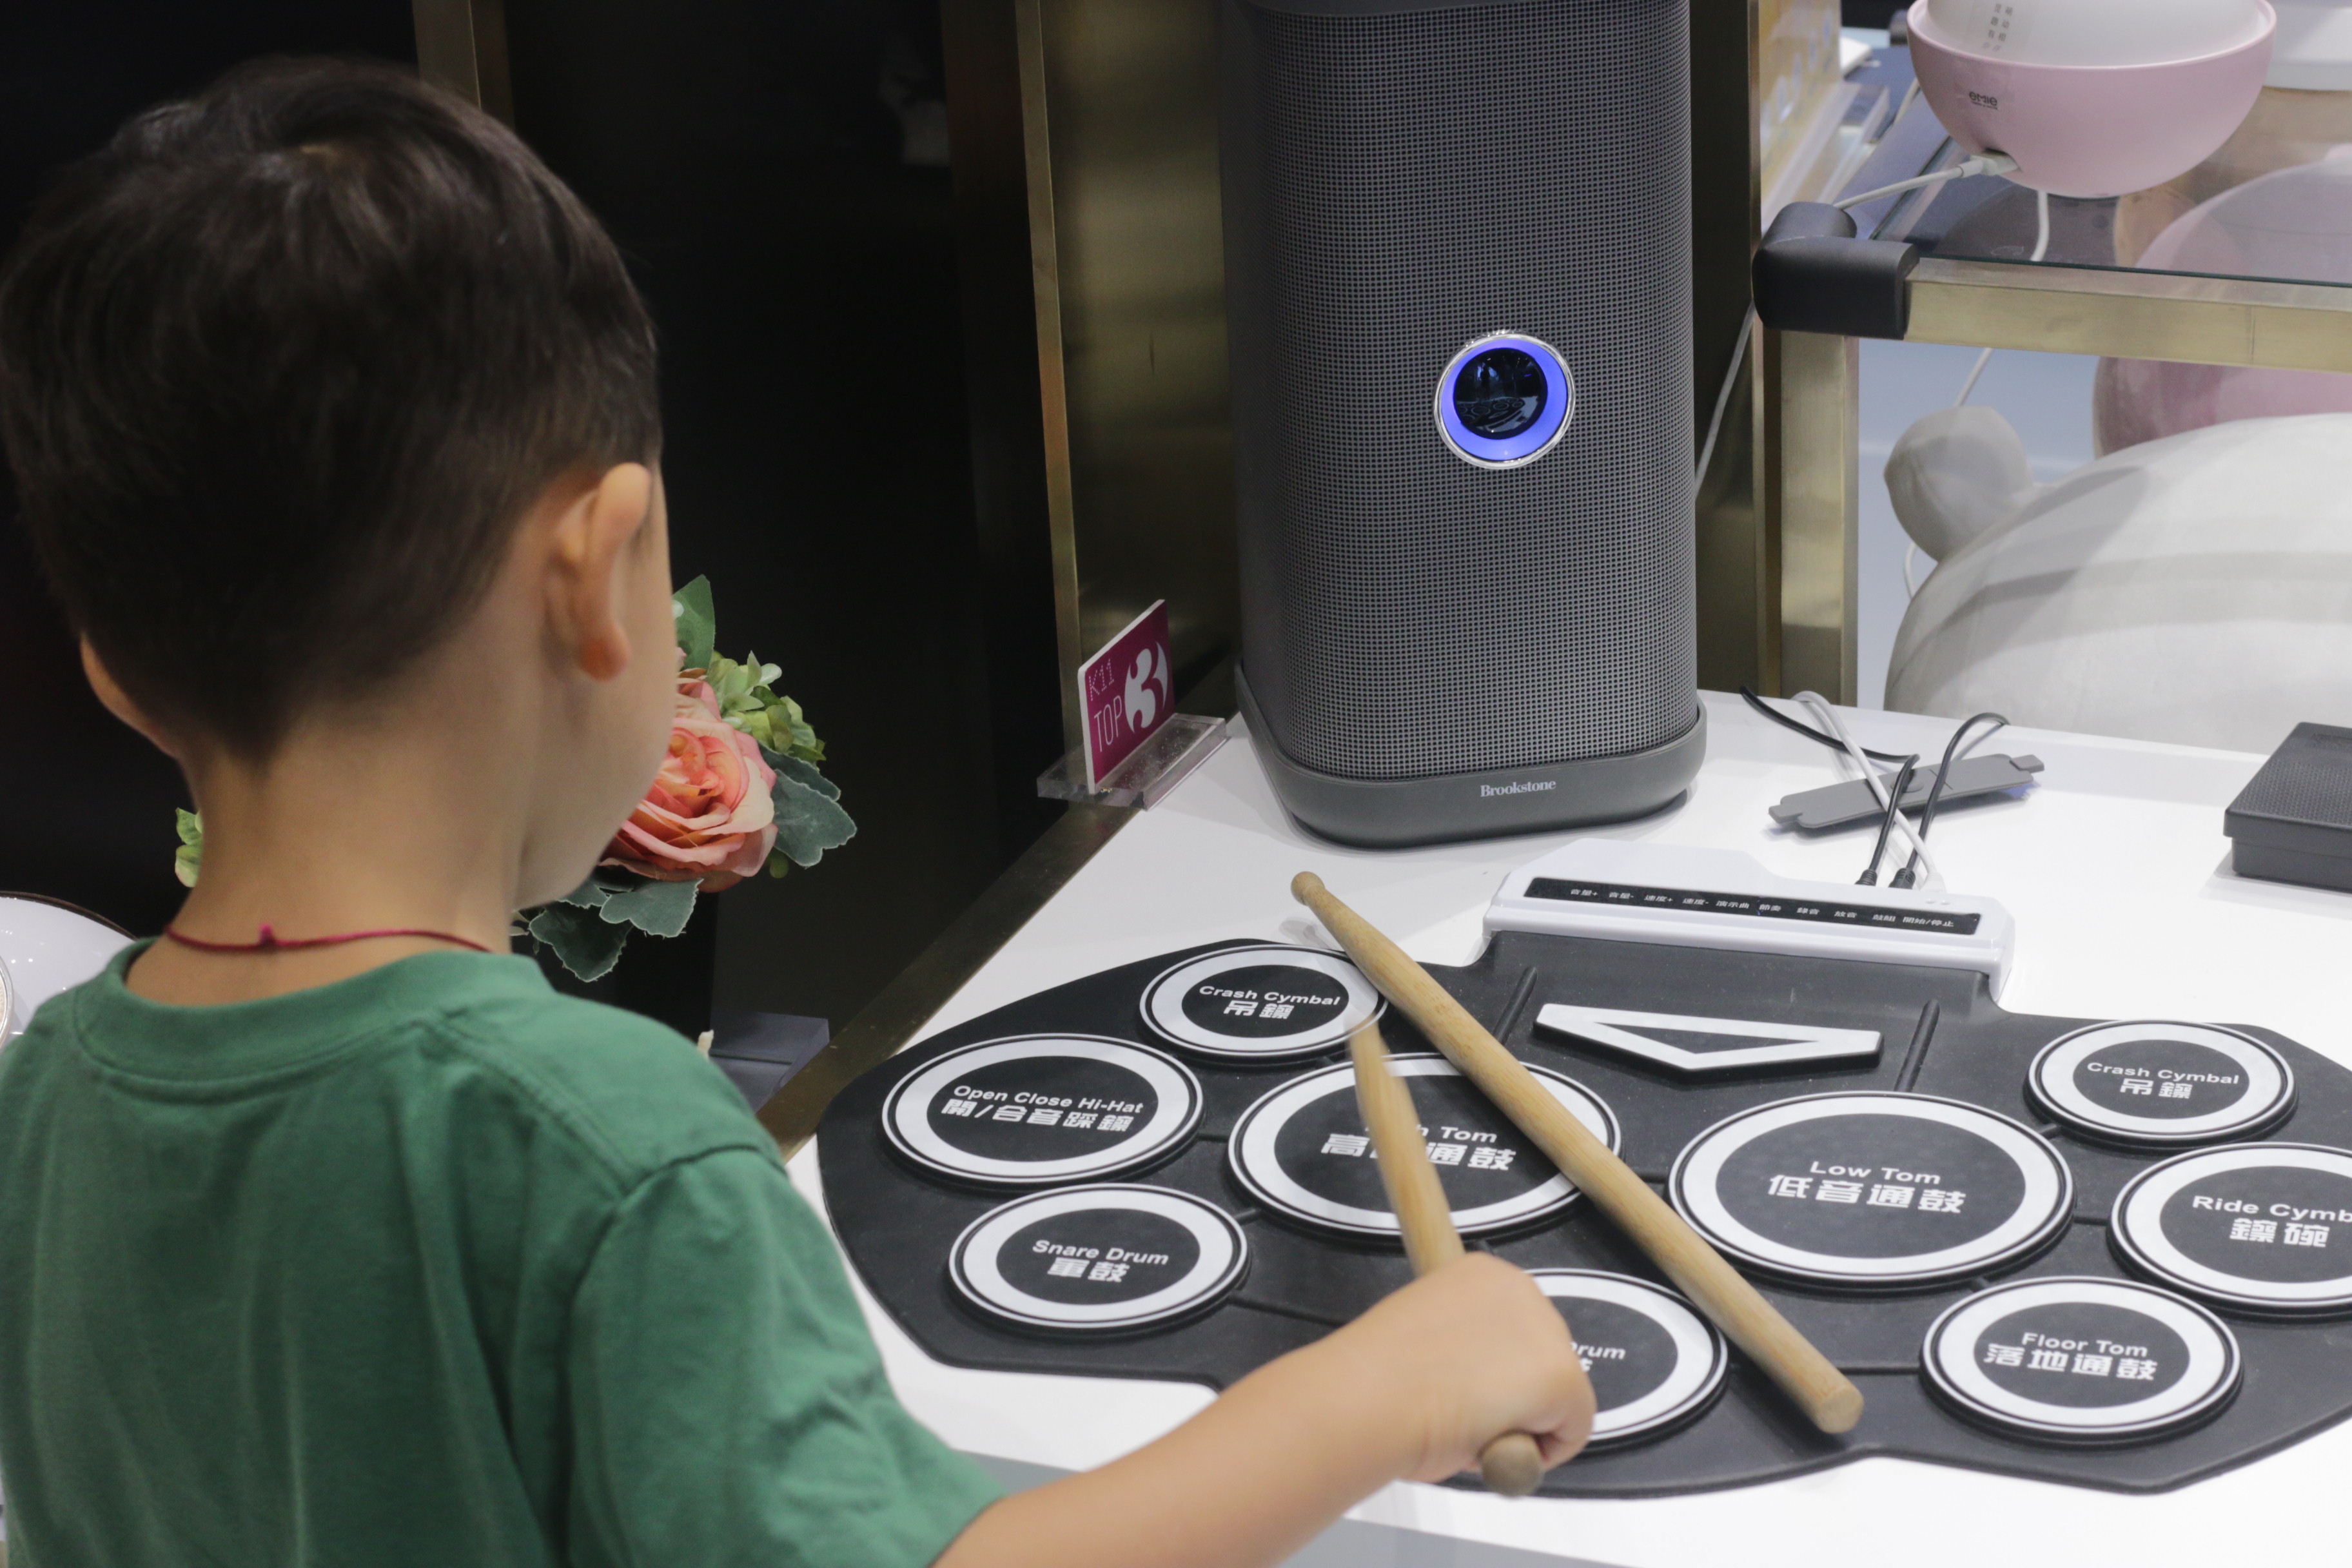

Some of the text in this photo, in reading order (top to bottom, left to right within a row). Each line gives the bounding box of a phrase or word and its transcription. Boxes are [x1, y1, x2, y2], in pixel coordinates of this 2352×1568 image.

[1088, 658, 1114, 701] K11
[1093, 642, 1168, 752] TOP 3
[1480, 781, 1556, 797] Brookstone
[1644, 894, 1673, 903] 速度+
[1715, 901, 1750, 909] 演示曲
[1199, 986, 1340, 1005] Crash Cymbal
[2087, 1062, 2239, 1084] Crash Cymbal
[954, 1085, 1144, 1113] Open Close Hi-Hat
[1441, 1126, 1498, 1143] Tom
[1320, 1133, 1516, 1171] 高通鼓
[1810, 1161, 1941, 1185] Low Tom
[1768, 1174, 1966, 1213] 低音通鼓
[2192, 1195, 2259, 1214] Ride
[1032, 1239, 1169, 1265] Snare Drum
[1047, 1257, 1130, 1282] 軍鼓
[2021, 1332, 2148, 1357] Floor Tom
[1983, 1343, 2158, 1380] 落地通鼓
